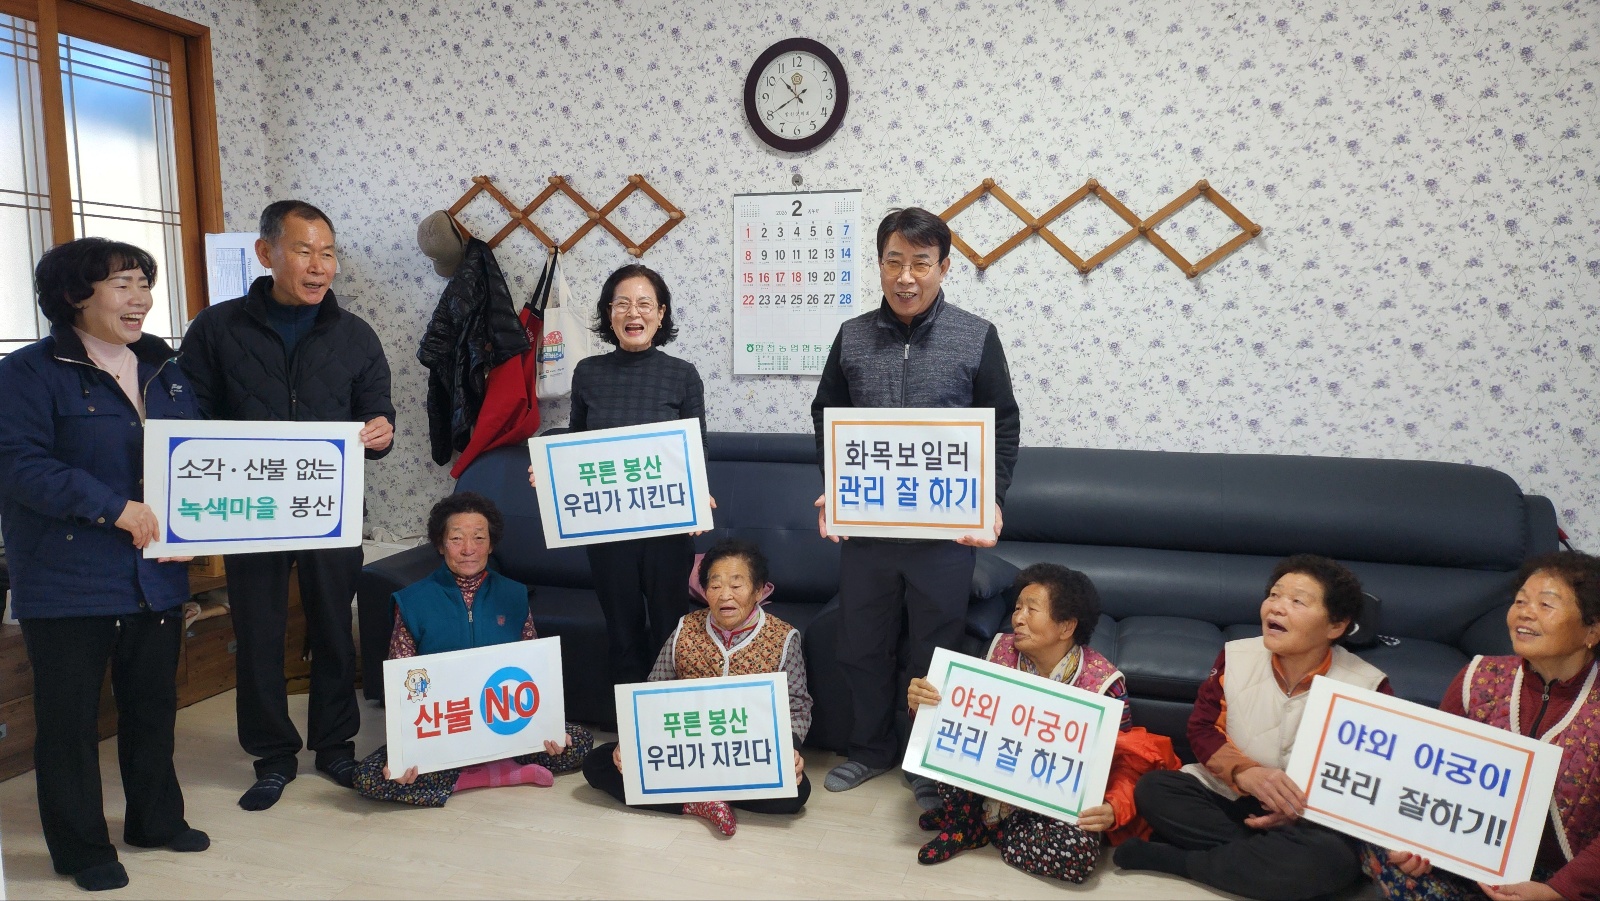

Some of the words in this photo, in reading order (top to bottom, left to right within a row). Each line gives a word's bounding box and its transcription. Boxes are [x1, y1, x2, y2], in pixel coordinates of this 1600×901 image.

[792, 56, 802, 67] 12
[813, 60, 815, 71] 1
[778, 63, 784, 73] 11
[766, 76, 775, 86] 10
[822, 71, 827, 81] 2
[762, 93, 769, 103] 9
[826, 89, 832, 100] 3
[767, 110, 774, 120] 8
[821, 107, 827, 117] 4
[780, 123, 785, 132] 7
[794, 125, 800, 135] 6
[810, 121, 816, 130] 5
[792, 200, 802, 216] 2
[747, 228, 749, 238] 1
[762, 228, 767, 237] 2
[778, 227, 783, 237] 3
[794, 227, 800, 237] 4
[810, 226, 816, 236] 5
[827, 226, 832, 236] 6
[844, 225, 849, 235] 7
[746, 251, 751, 260] 8
[762, 250, 767, 260] 9
[775, 250, 785, 260] 10
[793, 250, 800, 259] 11
[808, 249, 818, 259] 12
[825, 249, 834, 259] 13
[841, 248, 851, 258] 14
[744, 273, 753, 282] 15
[759, 273, 769, 282] 16
[776, 272, 785, 282] 17
[792, 272, 801, 282] 18
[808, 272, 817, 282] 19
[824, 272, 835, 281] 20
[842, 271, 850, 281] 21
[743, 295, 754, 305] 22
[759, 295, 770, 305] 23
[775, 295, 786, 304] 24
[791, 295, 802, 304] 25
[807, 294, 818, 304] 26
[824, 294, 835, 304] 27
[840, 294, 851, 304] 28
[845, 440, 968, 472] 화목보일러
[177, 458, 225, 481] 소각
[244, 458, 287, 480] 산불
[296, 458, 337, 480] 없는
[578, 460, 617, 486] 푸른
[623, 455, 662, 482] 봉산
[839, 476, 885, 508] 관리
[896, 477, 919, 507] 잘
[929, 477, 977, 509] 하기
[564, 489, 621, 517] 우리가
[627, 482, 685, 510] 지킨다
[178, 496, 278, 522] 녹색마을
[289, 495, 335, 518] 봉산
[414, 697, 473, 739] 산불
[484, 681, 540, 724] NO
[663, 711, 701, 738] 푸른
[709, 707, 748, 736] 봉산
[951, 686, 1001, 726] 야외
[1011, 704, 1089, 754] 아궁이
[647, 743, 705, 771] 우리가
[711, 738, 772, 767] 지킨다
[936, 718, 988, 762] 관리
[996, 737, 1023, 773] 잘
[1031, 748, 1084, 793] 하기
[1337, 720, 1397, 761] 야외
[1414, 743, 1512, 797] 아궁이
[1320, 761, 1381, 805] 관리
[1398, 786, 1507, 847] 잘하기!
